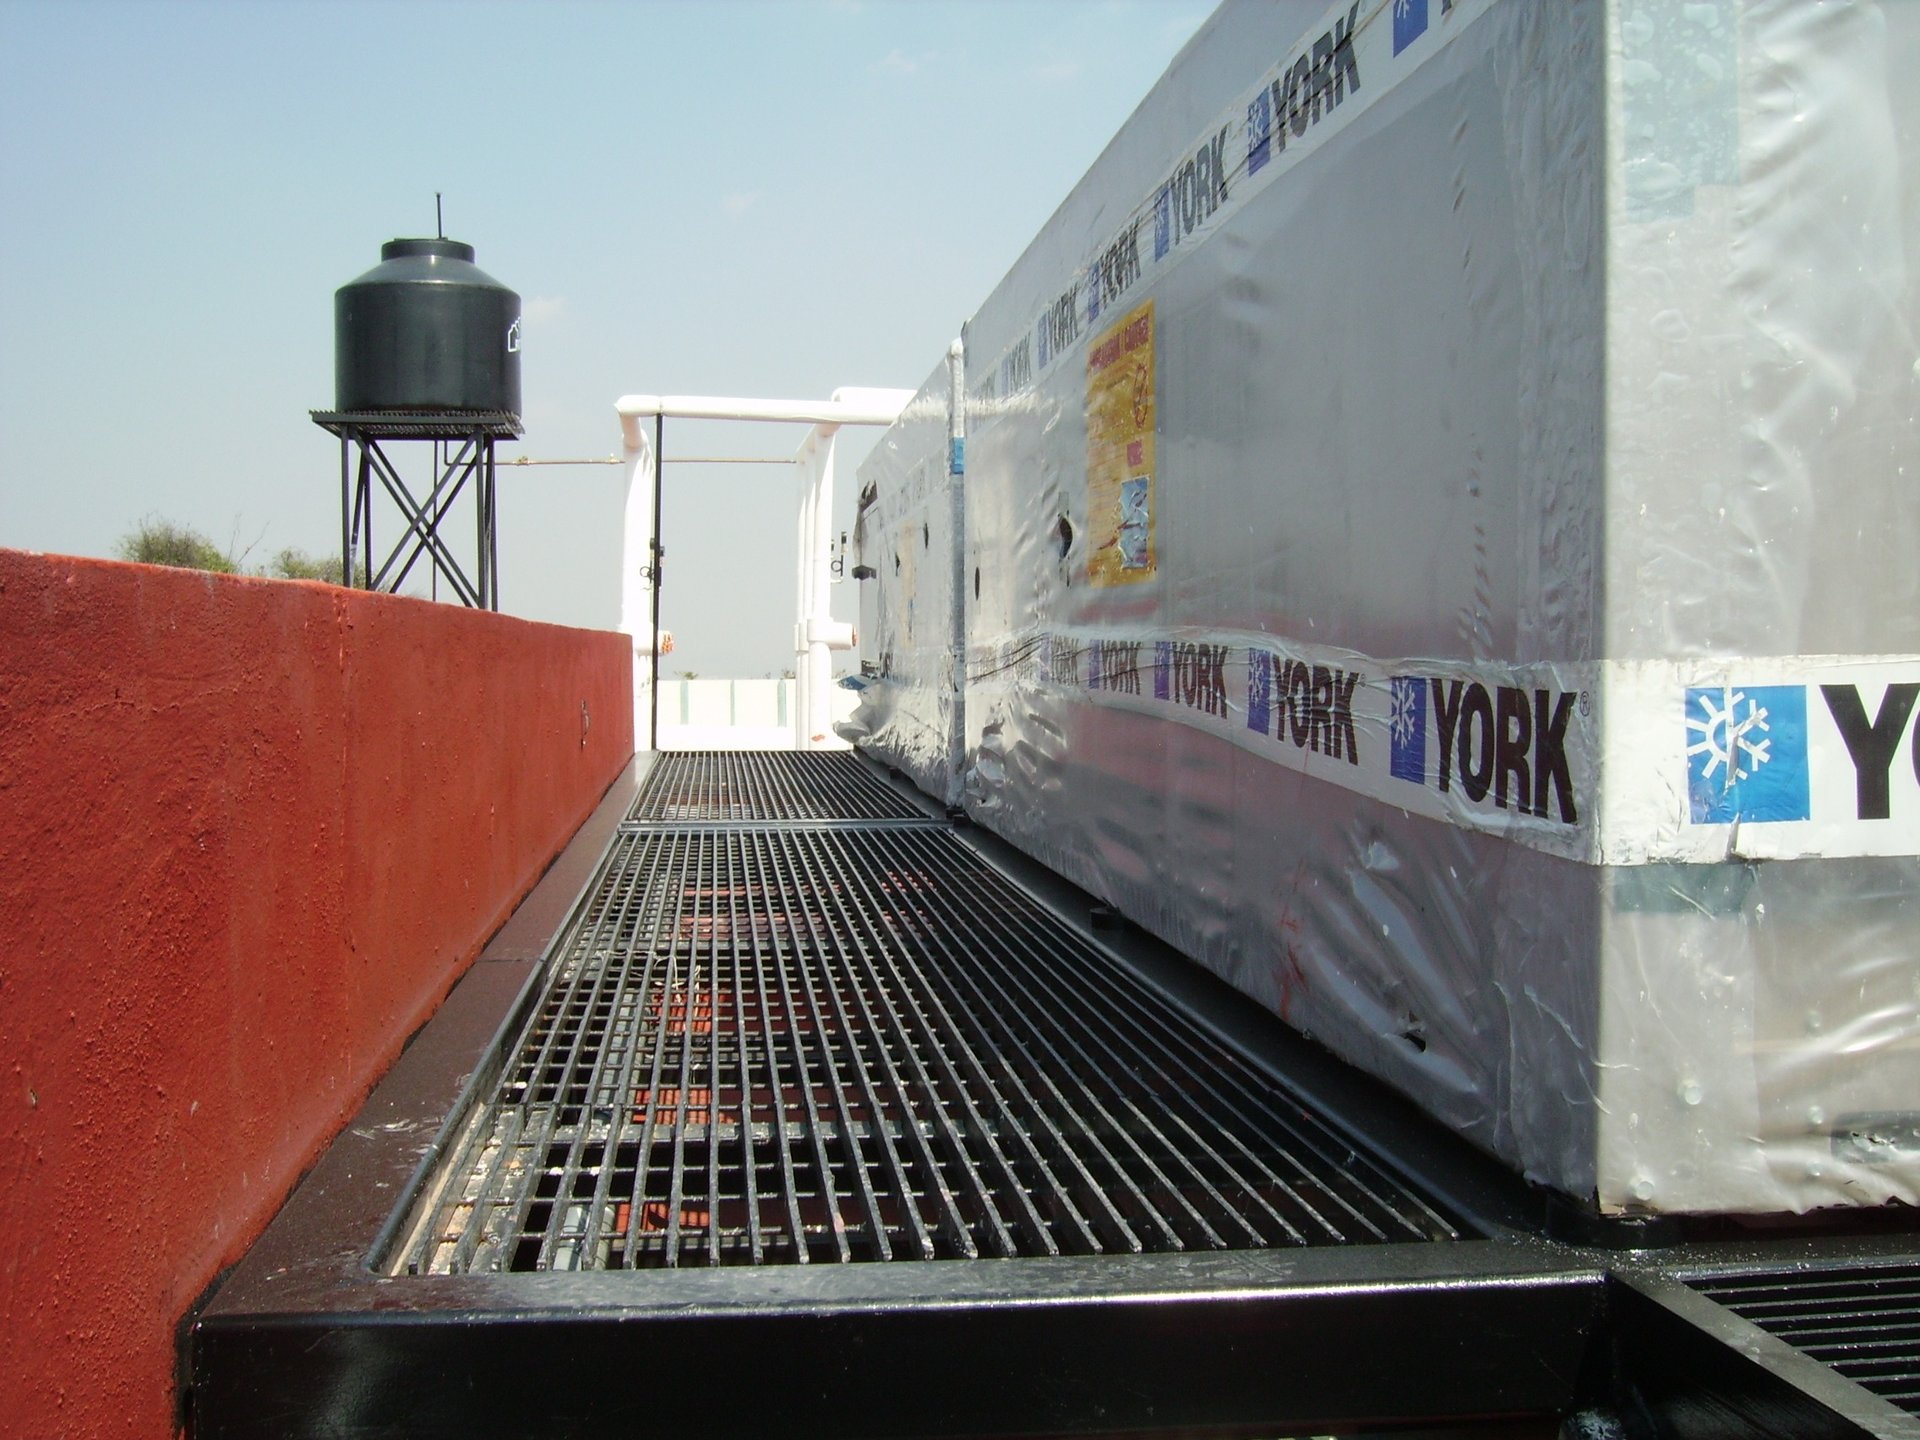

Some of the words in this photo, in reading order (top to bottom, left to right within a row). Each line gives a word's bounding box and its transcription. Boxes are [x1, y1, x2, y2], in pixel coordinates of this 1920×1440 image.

[1271, 0, 1360, 153] YORK
[1169, 125, 1228, 246] YORK
[1100, 214, 1141, 311] YORK
[1048, 281, 1079, 361] YORK
[1101, 639, 1142, 695] YORK
[1173, 641, 1229, 719] YORK
[1272, 653, 1360, 766] YORK
[1431, 677, 1577, 825] YORK
